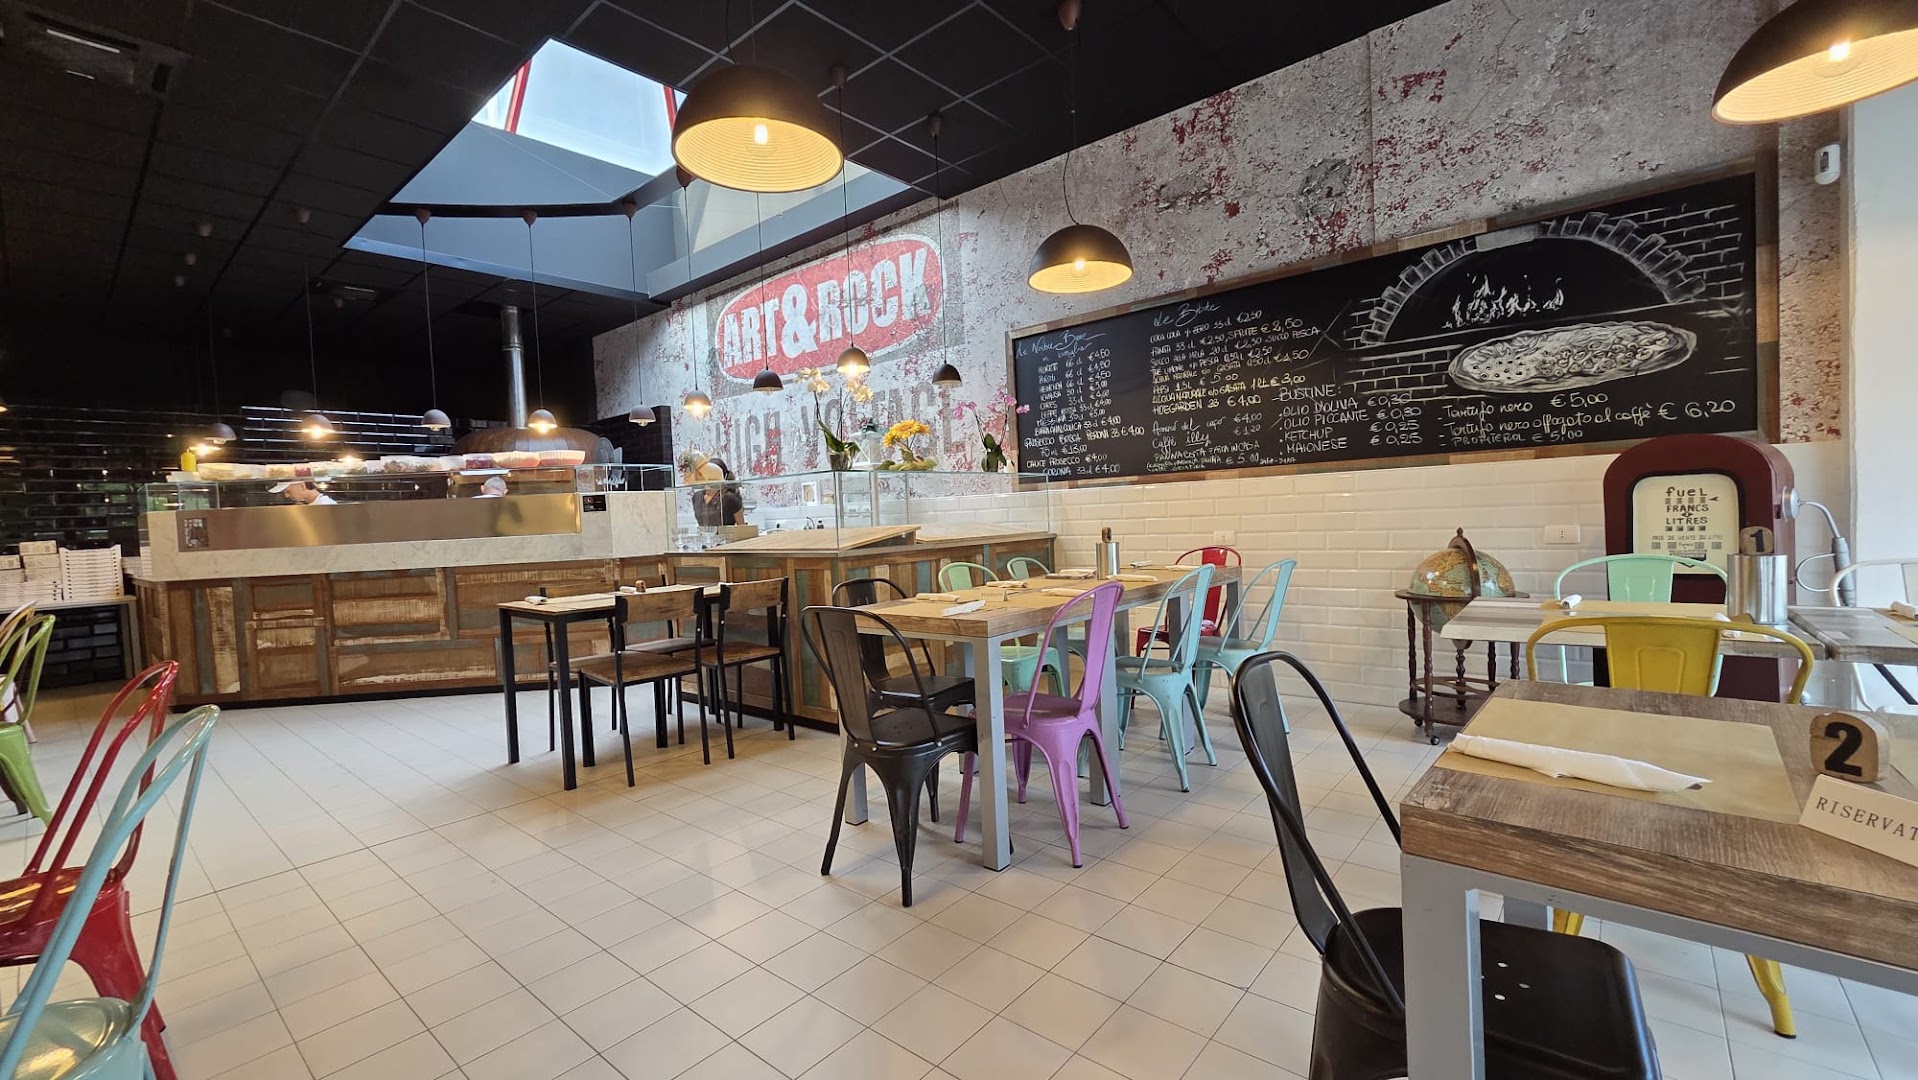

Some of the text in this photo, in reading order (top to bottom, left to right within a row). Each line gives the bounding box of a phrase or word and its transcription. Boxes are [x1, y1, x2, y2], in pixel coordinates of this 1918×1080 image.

[1500, 402, 1533, 414] nero
[1314, 409, 1370, 426] PICCANTE
[1500, 420, 1529, 431] nero
[1284, 427, 1333, 441] KETCHUP
[1666, 504, 1709, 513] FRANCS
[1666, 516, 1708, 525] LITRES
[1824, 721, 1863, 777] 2
